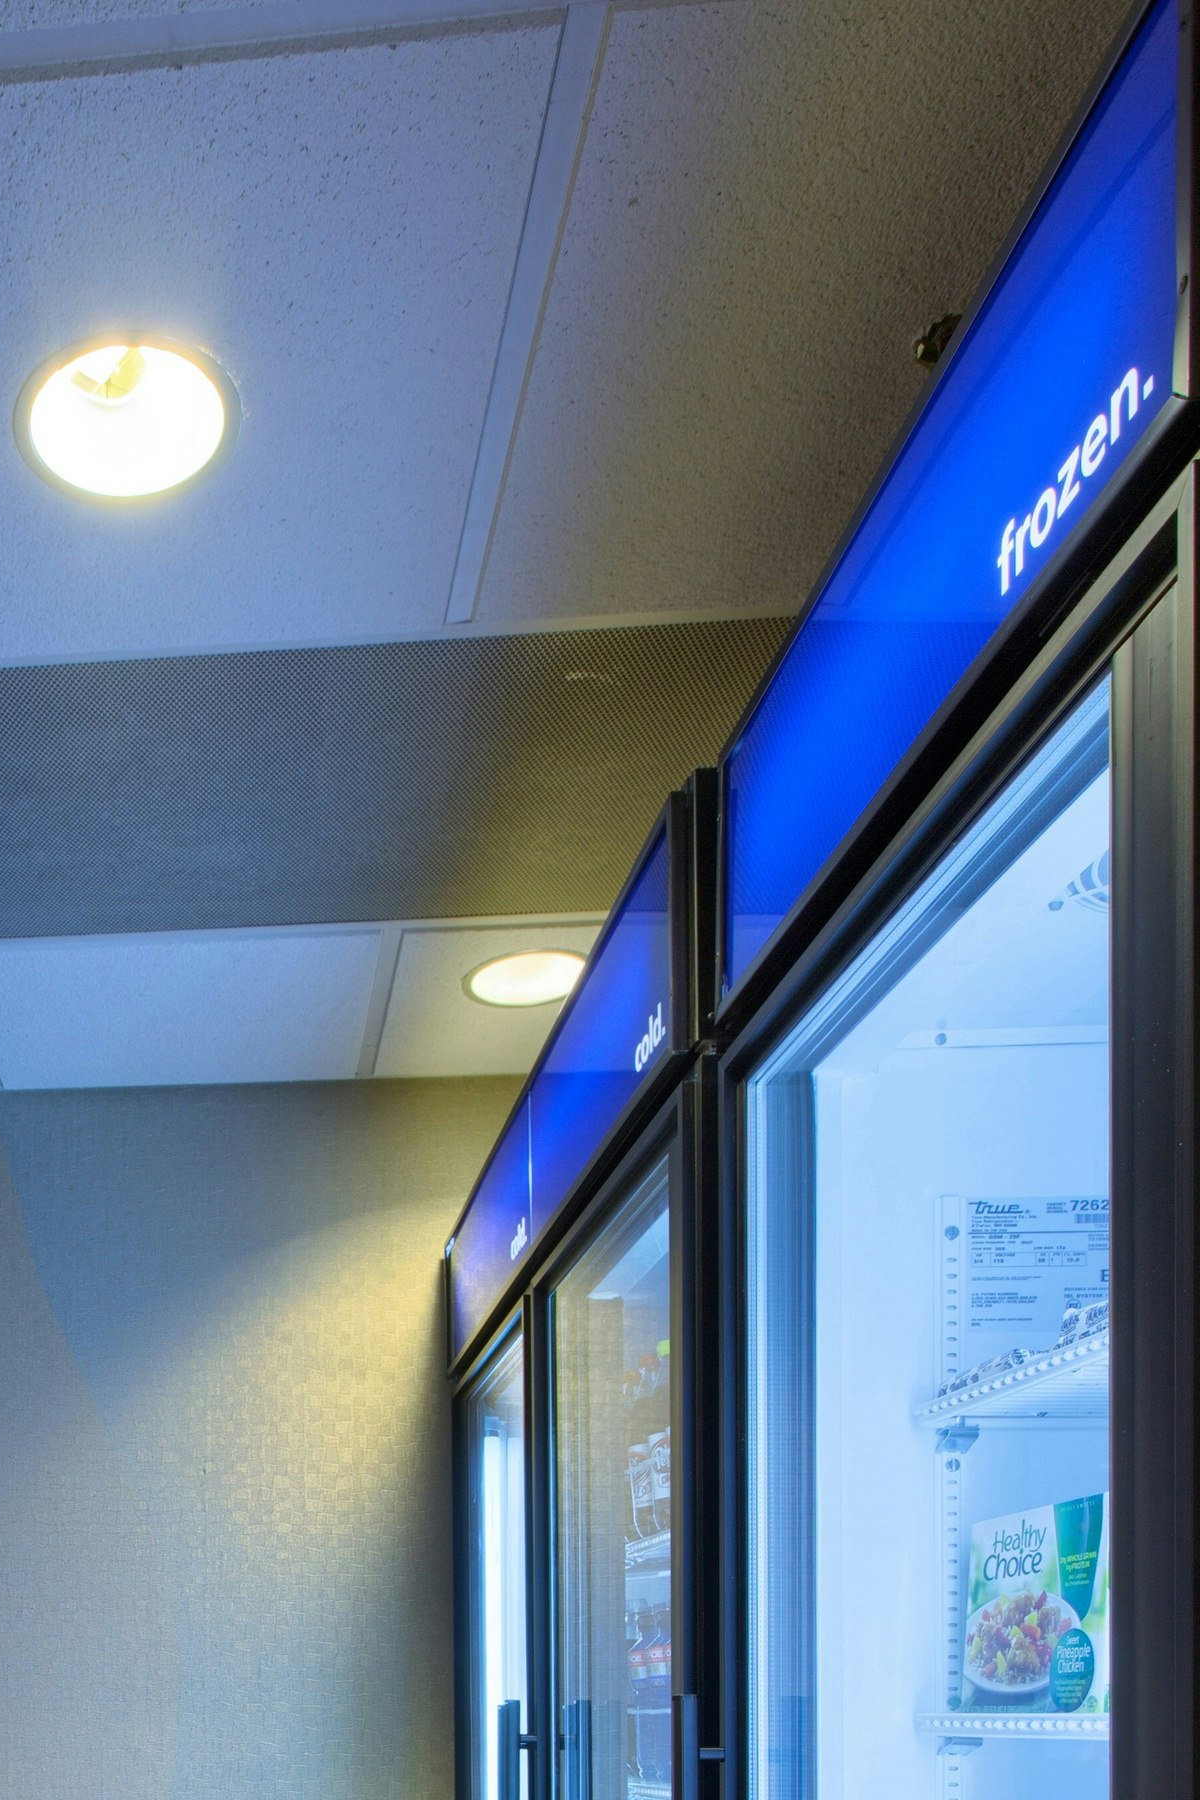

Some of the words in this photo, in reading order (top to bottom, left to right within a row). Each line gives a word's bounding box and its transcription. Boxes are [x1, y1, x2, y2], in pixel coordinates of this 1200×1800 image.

[997, 367, 1154, 597] frozen.
[634, 1002, 666, 1073] cold.
[510, 1217, 527, 1261] cold.
[993, 1519, 1047, 1554] Healthy
[983, 1548, 1043, 1582] Choice
[1056, 1643, 1091, 1662] Pineapple
[1057, 1660, 1085, 1674] Chicken
